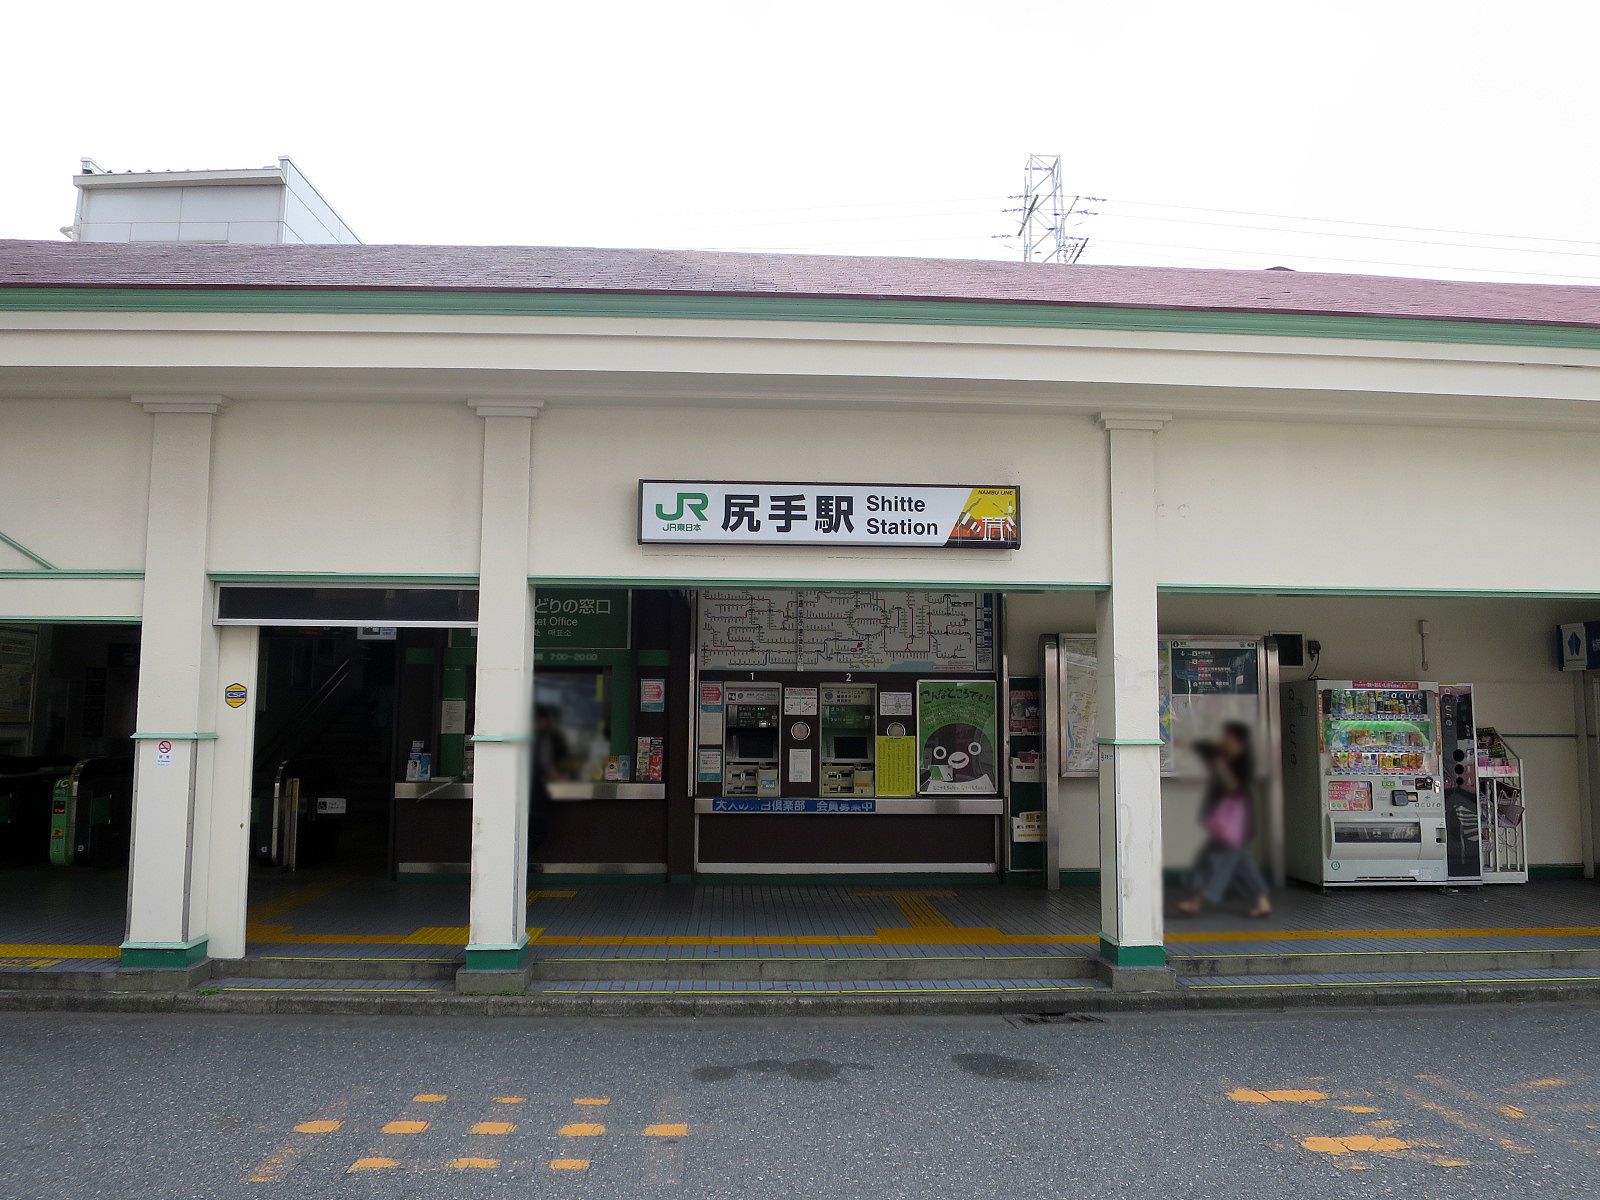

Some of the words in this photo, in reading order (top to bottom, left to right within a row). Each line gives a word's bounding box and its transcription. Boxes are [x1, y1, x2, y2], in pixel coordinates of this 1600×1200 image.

[656, 492, 709, 521] JR
[866, 494, 926, 513] Shitte
[721, 494, 854, 534] 尻手駅
[662, 523, 702, 532] JR東日本
[866, 517, 938, 536] Station
[549, 616, 578, 626] Office
[749, 672, 755, 681] 1
[845, 672, 853, 682] 2
